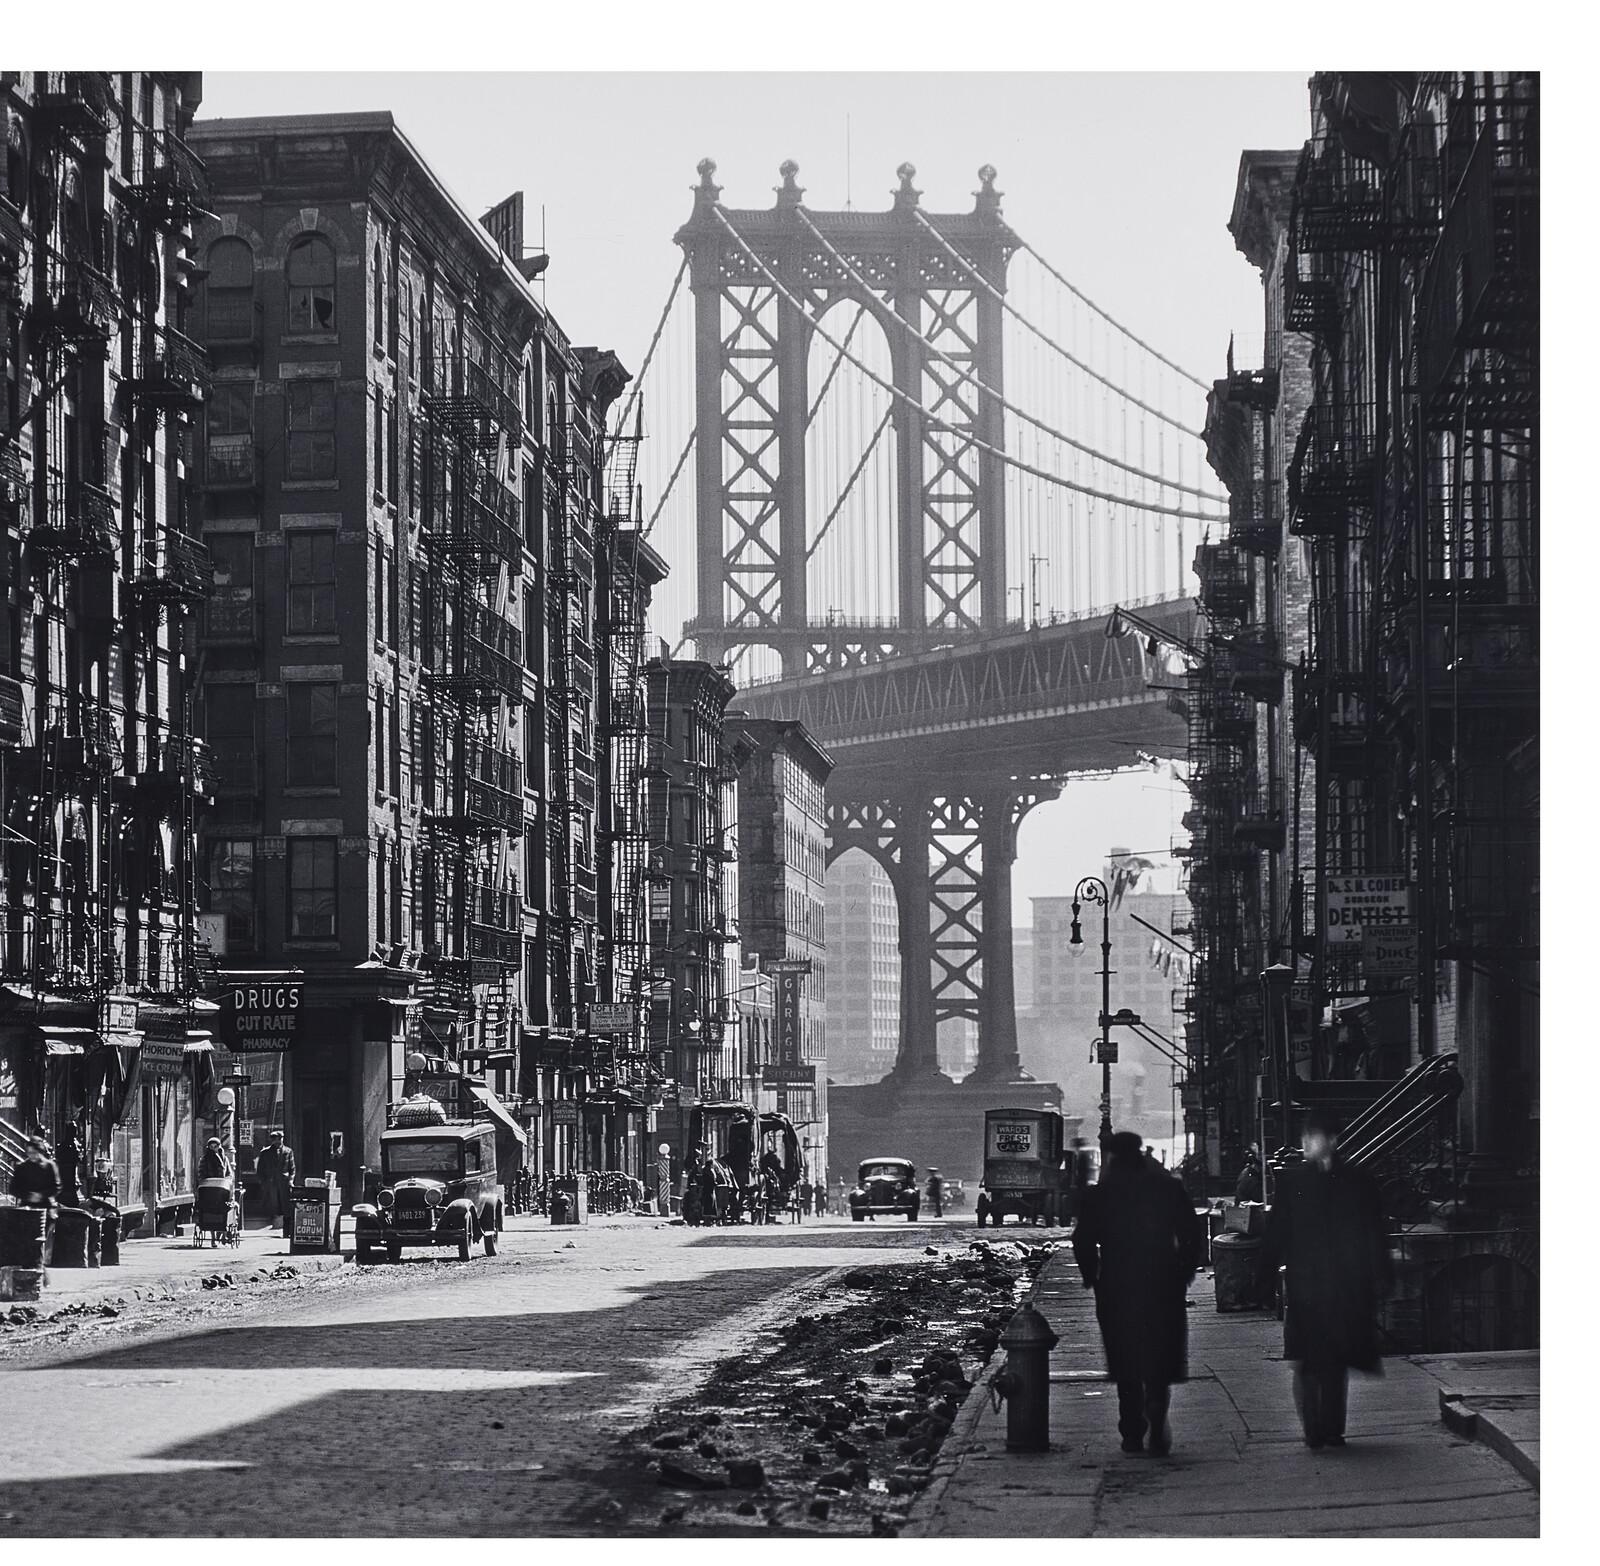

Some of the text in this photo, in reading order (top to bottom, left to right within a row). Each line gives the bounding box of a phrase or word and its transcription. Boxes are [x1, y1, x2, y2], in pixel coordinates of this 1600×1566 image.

[1329, 906, 1405, 926] DENTIST
[235, 988, 299, 1009] DRUGS
[236, 1015, 297, 1031] CUT RATE
[784, 978, 793, 1062] GARAGE
[243, 1038, 290, 1049] PHARMACY
[1000, 1134, 1028, 1142] FRESH
[302, 1218, 317, 1226] BILL
